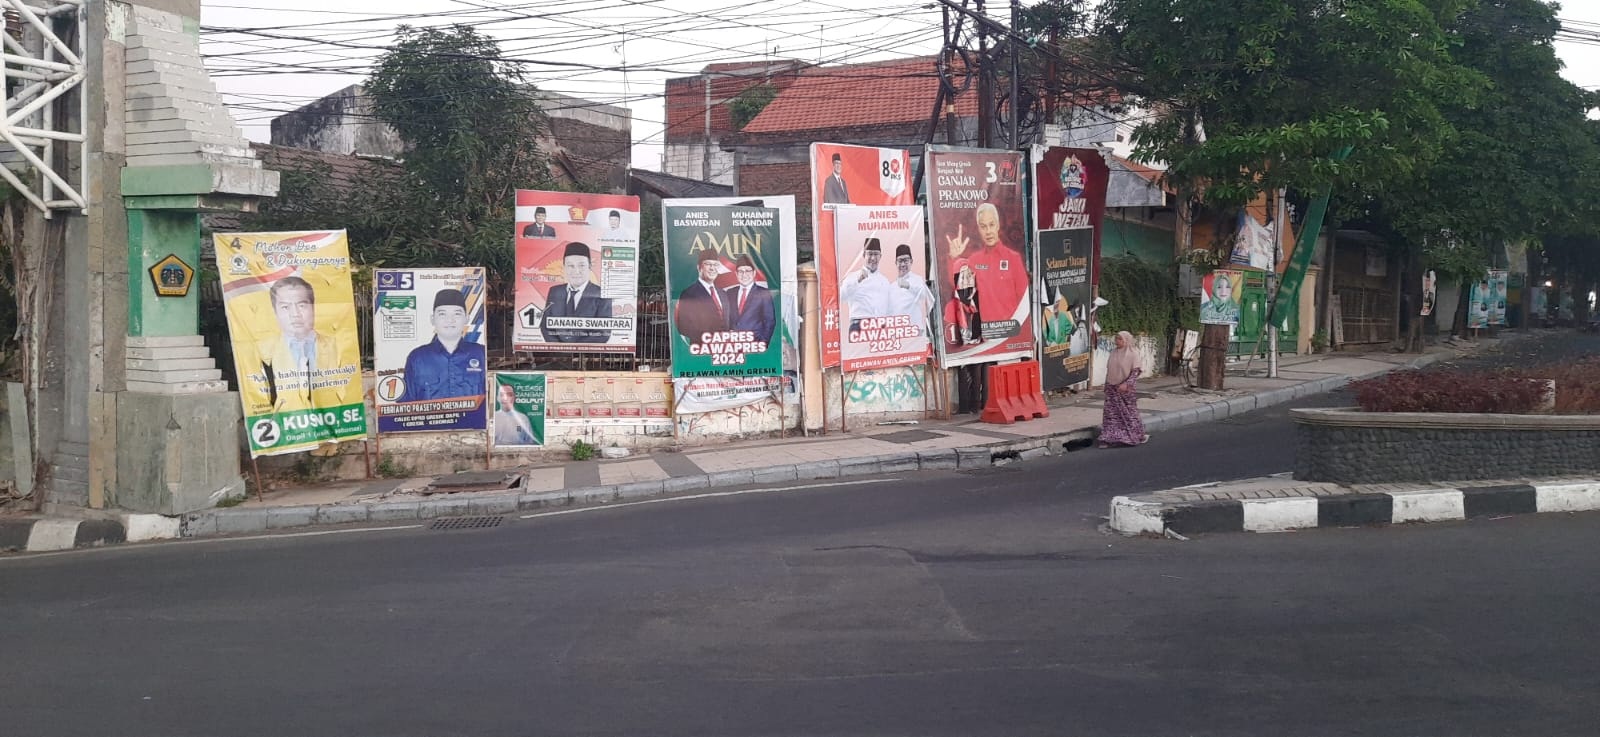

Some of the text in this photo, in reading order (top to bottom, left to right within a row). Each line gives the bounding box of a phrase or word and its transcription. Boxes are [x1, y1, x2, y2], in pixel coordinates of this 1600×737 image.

[882, 161, 890, 177] 8
[985, 162, 997, 183] 3
[938, 176, 976, 186] GANJAR
[939, 189, 989, 200] PRANOWO
[731, 211, 773, 219] MUHAIMIN
[869, 211, 898, 219] ANIES
[1053, 212, 1090, 228] WETAN
[858, 221, 909, 231] MUHAIMIN
[231, 237, 241, 249] 4
[688, 231, 762, 260] AMIN
[277, 253, 346, 267] Dukungannya
[1046, 257, 1067, 269] Selamat
[400, 273, 412, 289] 5
[524, 308, 535, 326] 1
[547, 319, 631, 328] DANANG SWANTARA
[860, 316, 910, 330] CAPRES
[702, 331, 754, 343] CAPRES
[850, 326, 919, 343] CAWAPRES
[950, 325, 956, 342] 1
[690, 342, 767, 355] CAWAPRES
[869, 340, 901, 353] 2024
[712, 354, 745, 365] 2024
[851, 360, 881, 369] RELAWAN
[680, 369, 720, 378] RELAWAN
[723, 368, 744, 376] AMIN
[386, 379, 397, 398] 1
[343, 408, 363, 422] SE.
[381, 403, 410, 415] FEBRIANTO
[413, 402, 441, 411] PRASETYO
[257, 422, 275, 443] 2
